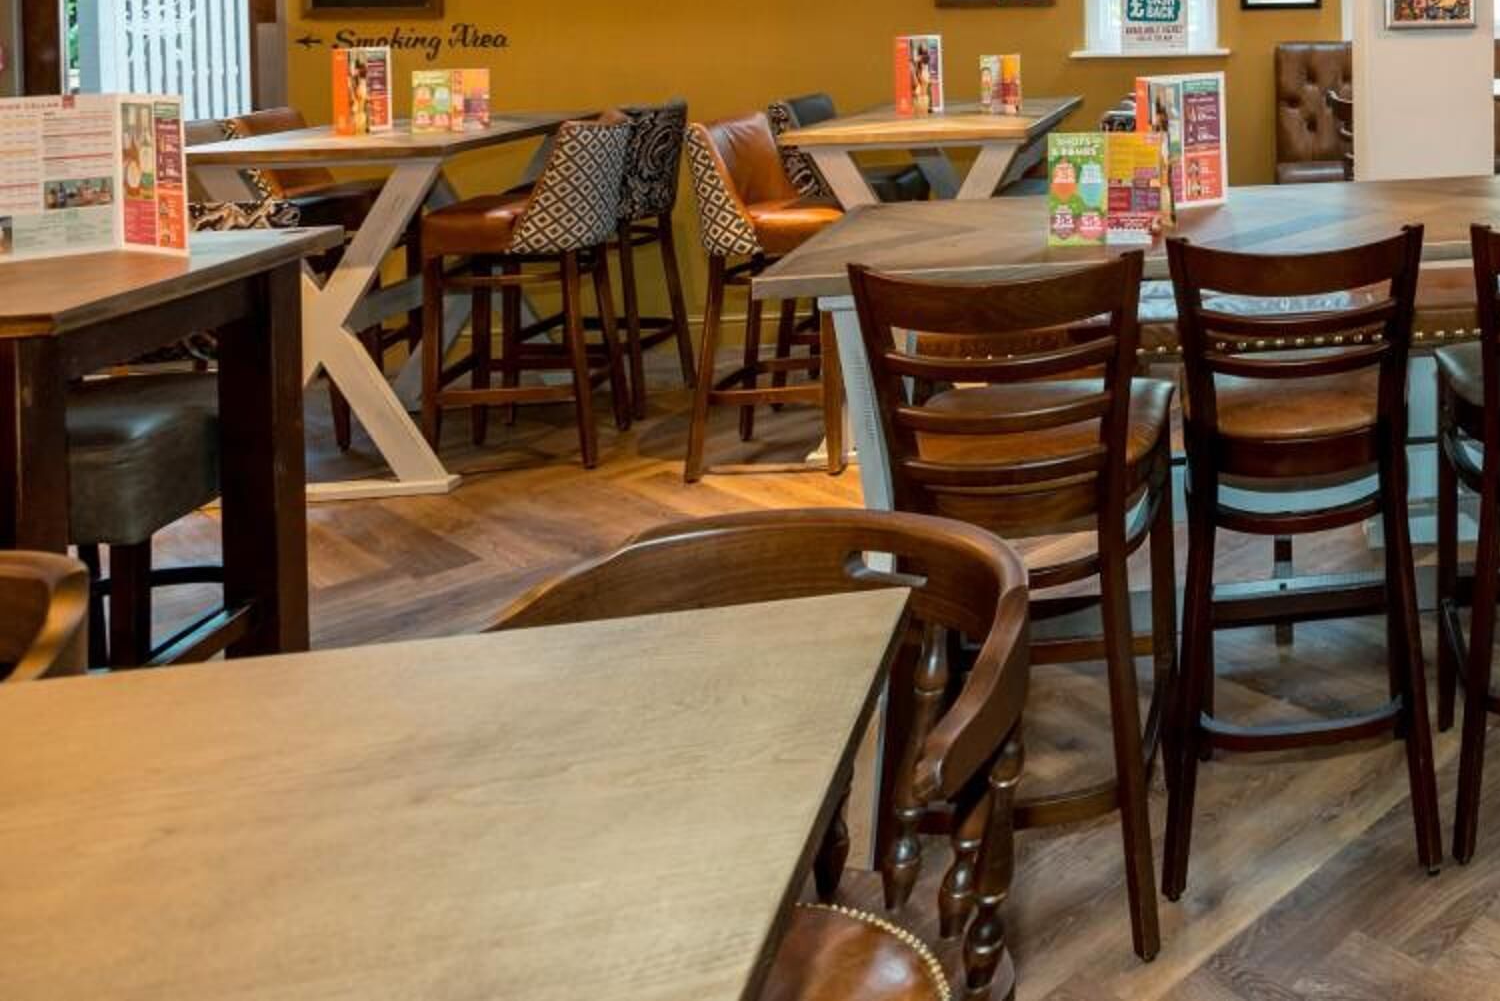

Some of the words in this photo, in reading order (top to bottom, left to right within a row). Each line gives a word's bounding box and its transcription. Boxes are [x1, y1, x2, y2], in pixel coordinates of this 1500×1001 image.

[1146, 6, 1175, 20] BACK
[333, 27, 442, 61] Smoking
[448, 23, 510, 49] Area
